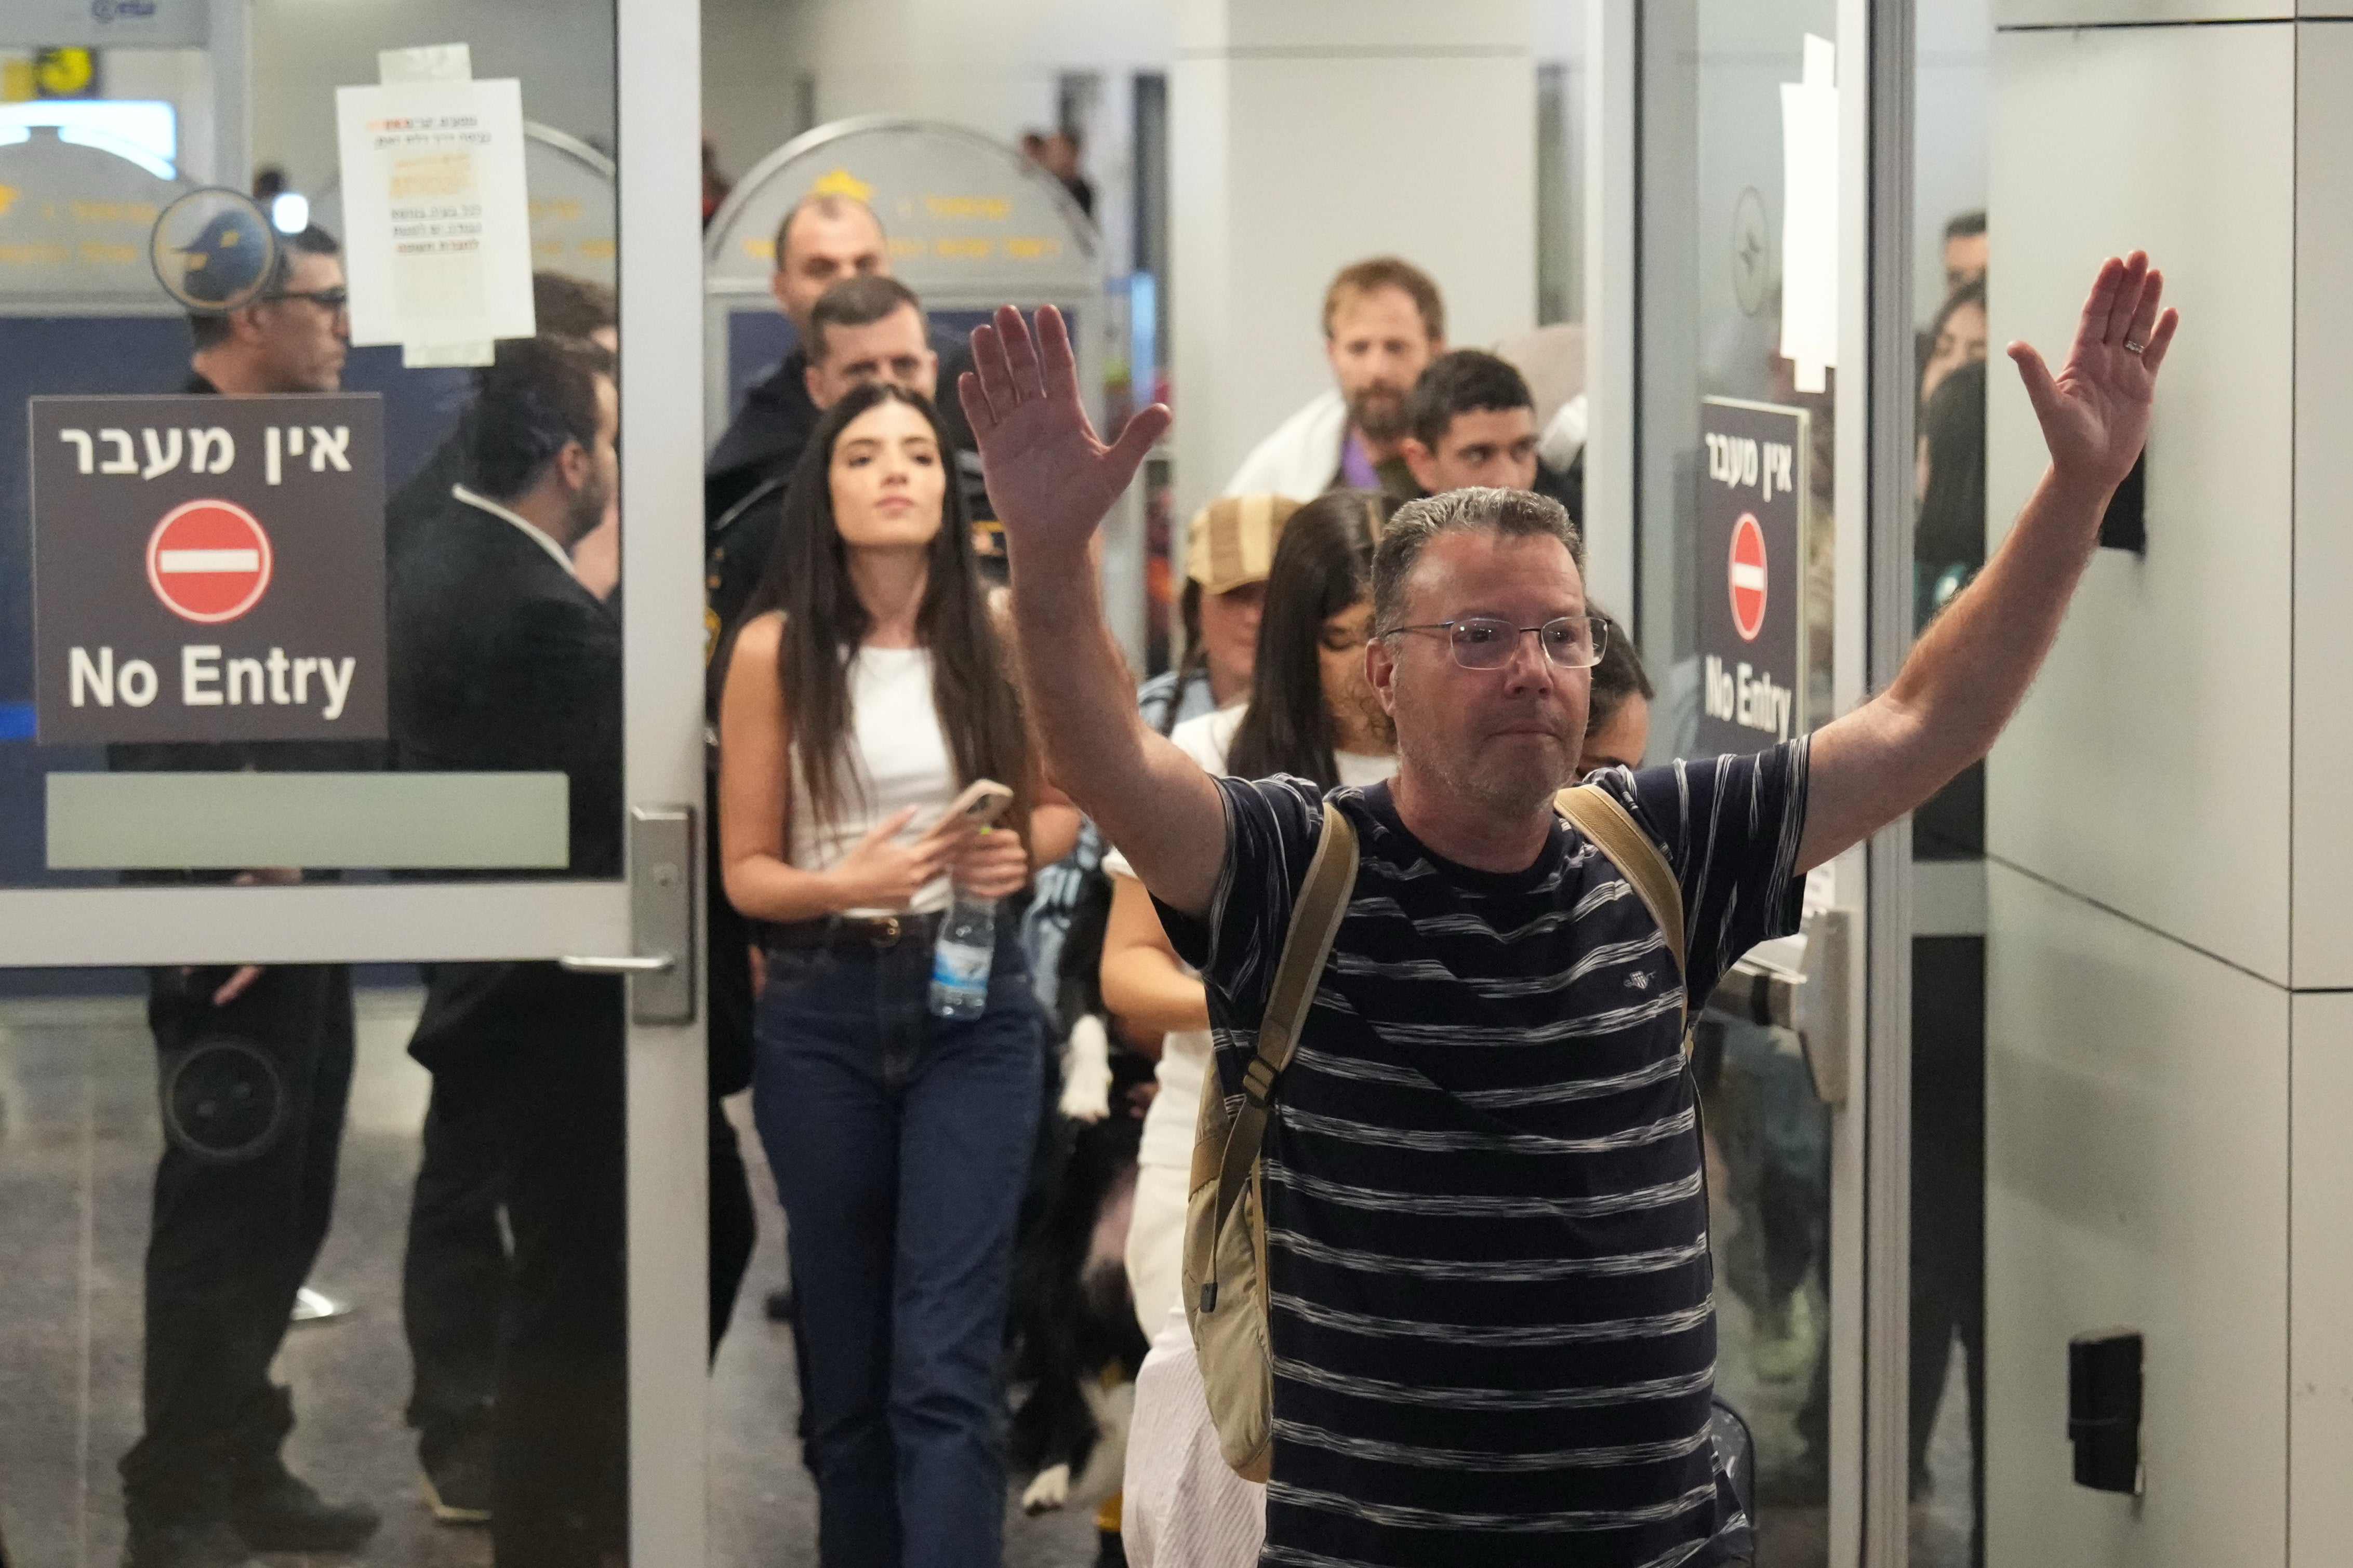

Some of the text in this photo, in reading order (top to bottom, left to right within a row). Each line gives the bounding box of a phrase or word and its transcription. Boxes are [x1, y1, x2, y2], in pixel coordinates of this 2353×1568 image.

[60, 426, 352, 485] אין מעבר
[1706, 433, 1791, 502] אין מעבר
[70, 645, 356, 719] No Entry
[1706, 655, 1792, 744] No Entry
